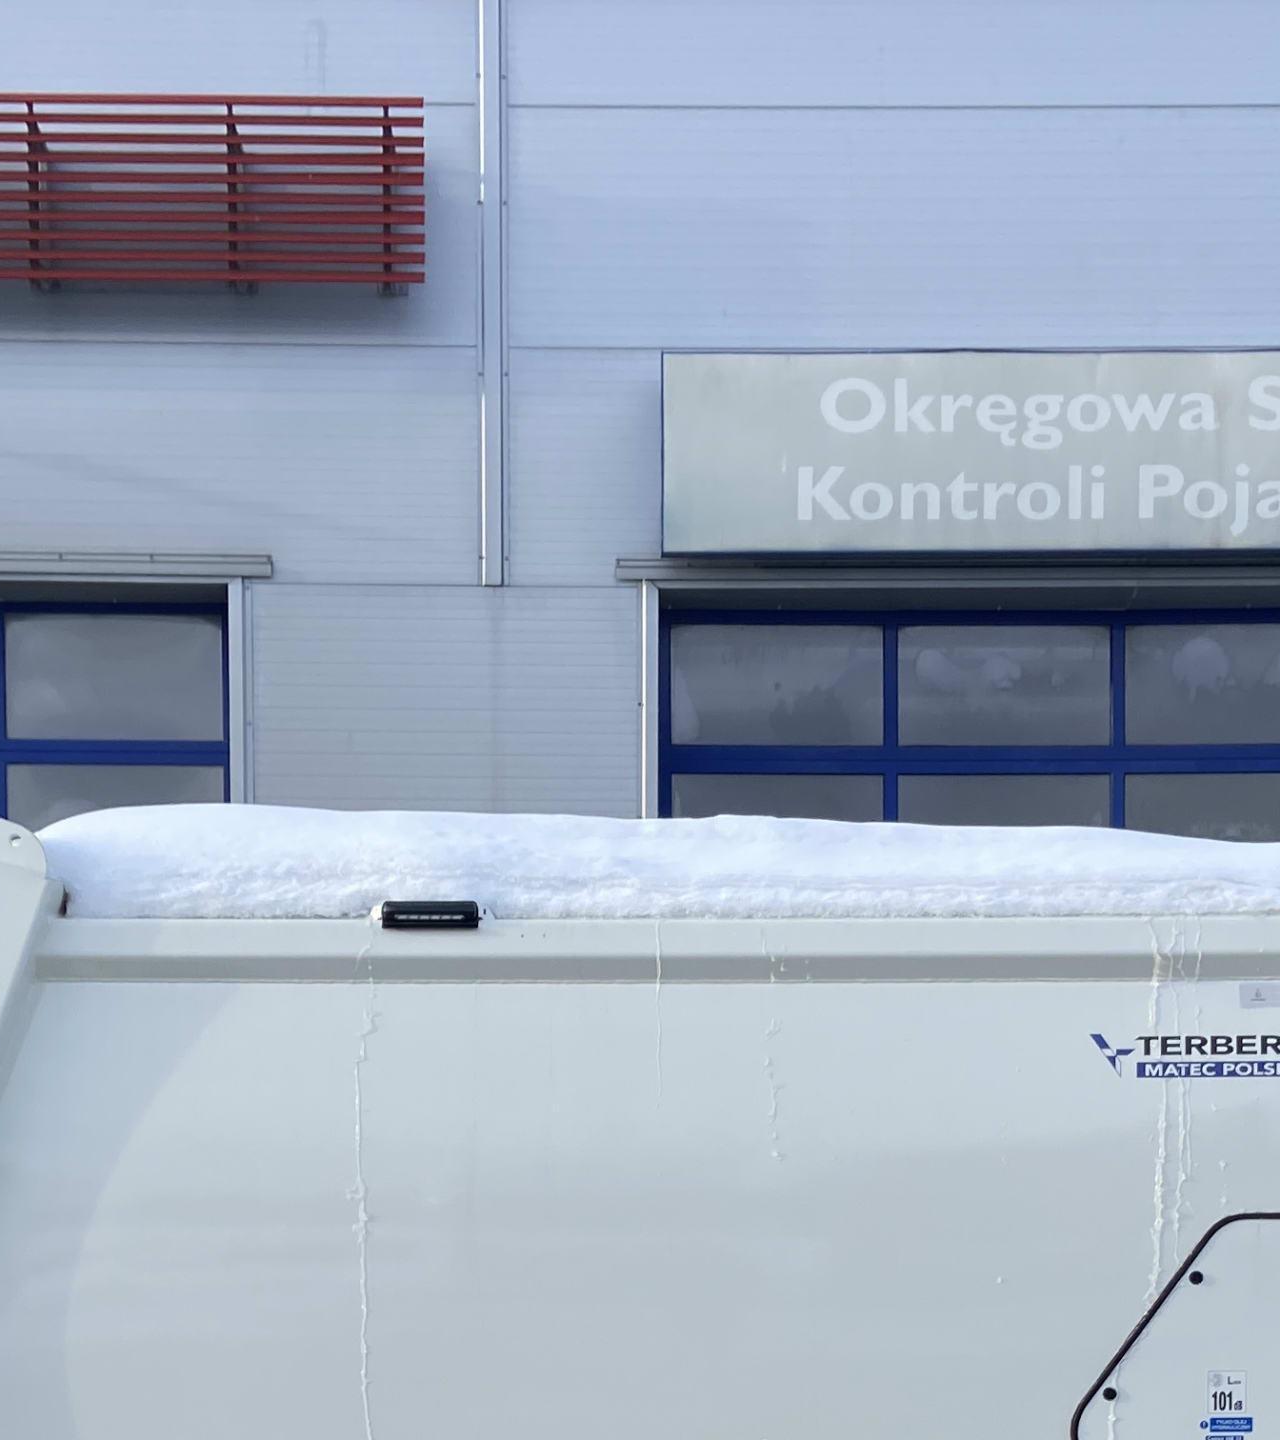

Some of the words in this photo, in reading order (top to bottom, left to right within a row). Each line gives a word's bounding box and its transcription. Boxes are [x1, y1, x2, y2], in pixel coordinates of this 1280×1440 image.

[818, 375, 1220, 451] Okręgowa
[796, 463, 1105, 522] Kontroli
[1144, 1062, 1216, 1077] MATEC
